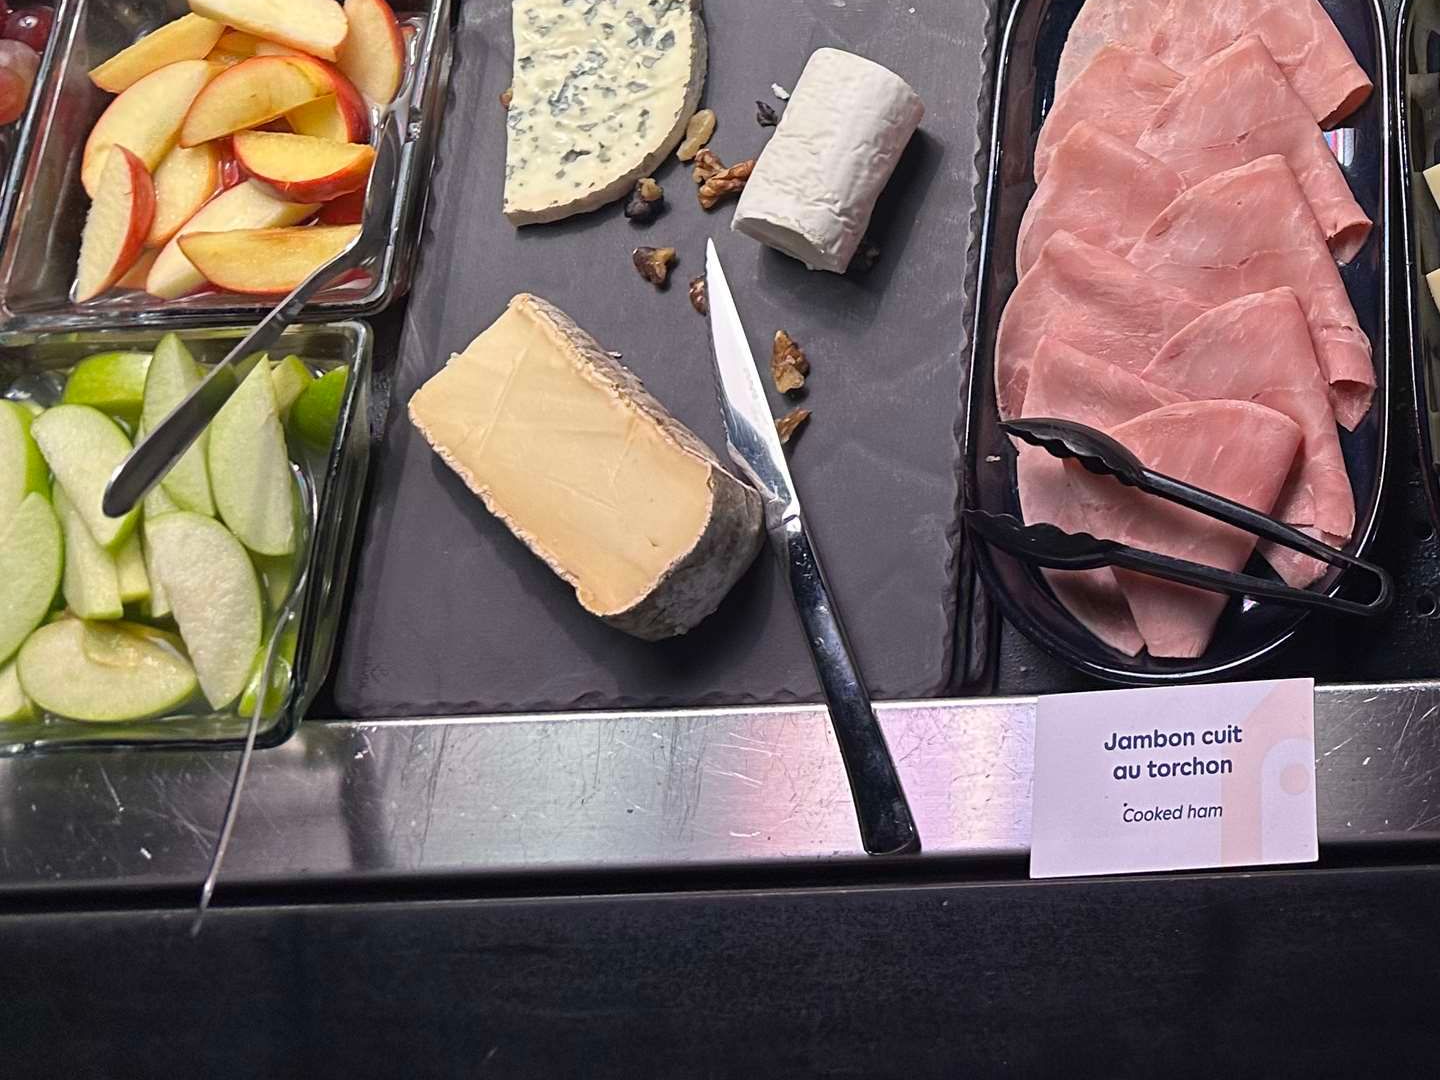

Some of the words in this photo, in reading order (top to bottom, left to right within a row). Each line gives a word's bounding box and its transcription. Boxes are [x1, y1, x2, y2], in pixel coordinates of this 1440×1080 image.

[1104, 729, 1195, 751] Jambon
[1202, 725, 1242, 745] cuit
[1113, 764, 1140, 780] au
[1147, 757, 1233, 778] torchon
[1122, 804, 1183, 823] Cooked
[1188, 804, 1223, 818] ham
